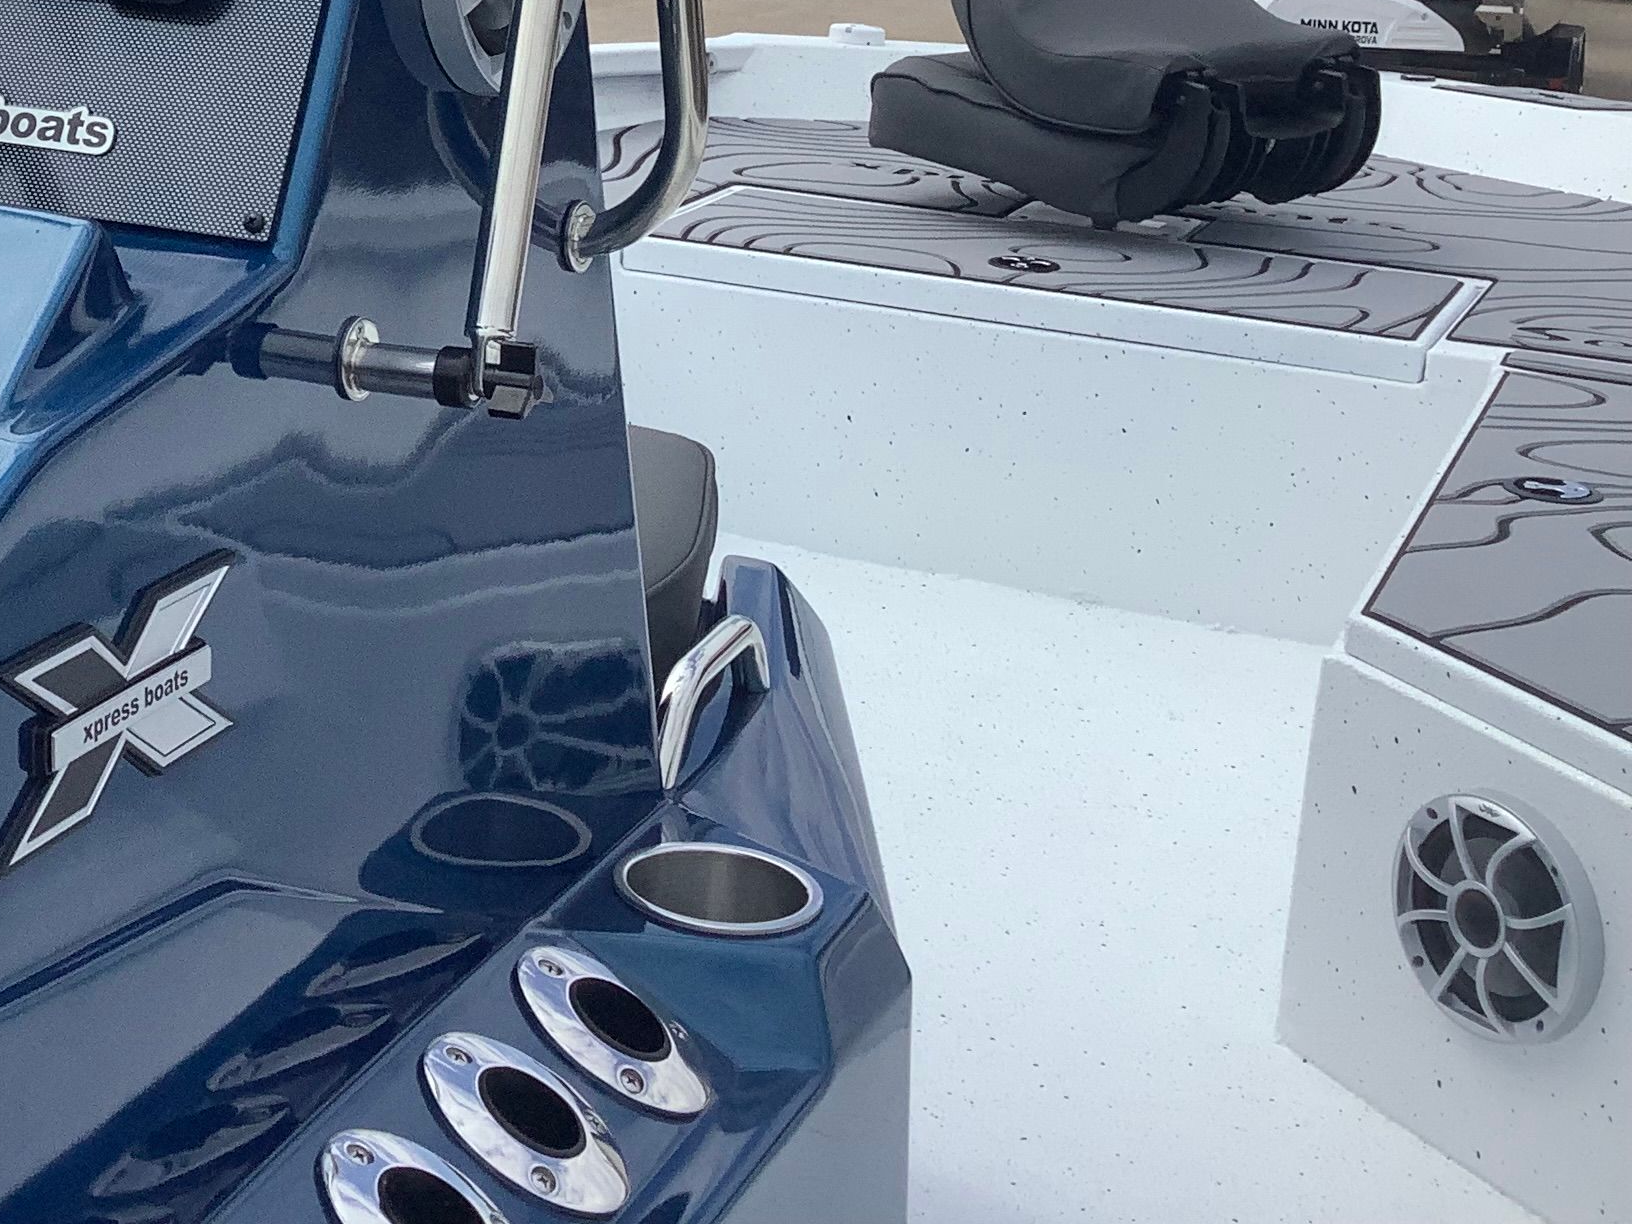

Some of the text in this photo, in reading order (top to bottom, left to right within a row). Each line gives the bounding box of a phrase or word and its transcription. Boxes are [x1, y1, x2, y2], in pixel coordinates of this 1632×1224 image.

[1300, 18, 1378, 34] MINN KOTA
[82, 667, 189, 744] xpress boats
